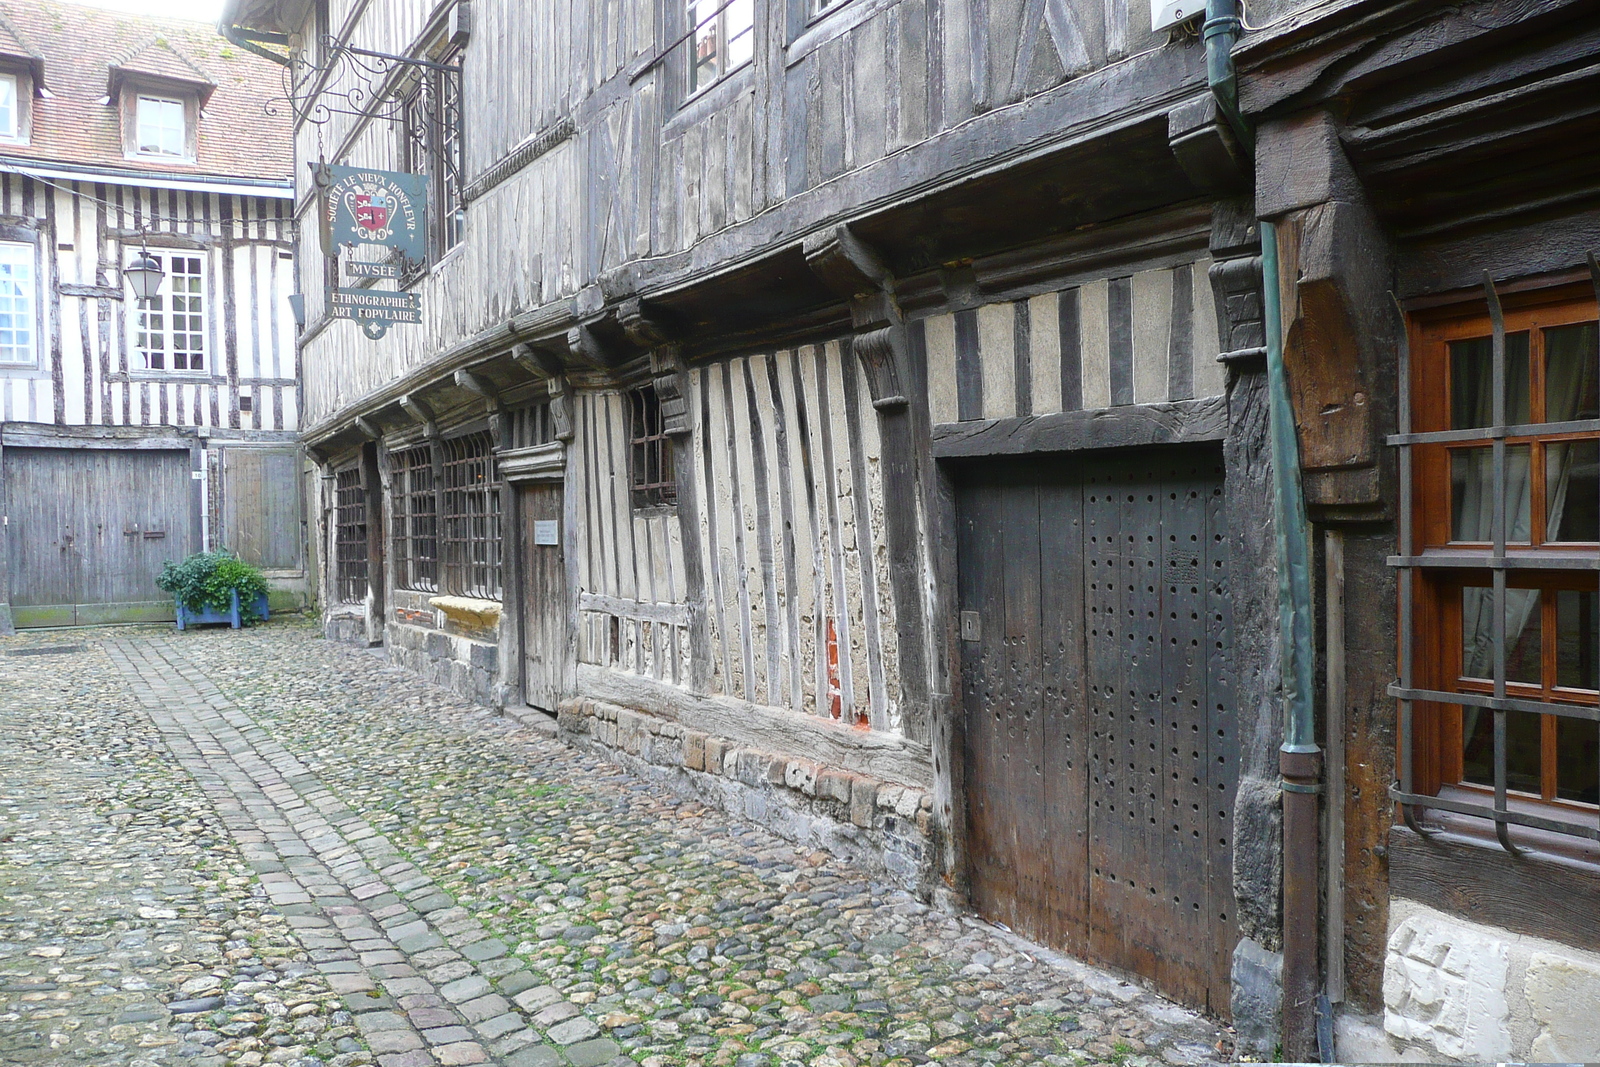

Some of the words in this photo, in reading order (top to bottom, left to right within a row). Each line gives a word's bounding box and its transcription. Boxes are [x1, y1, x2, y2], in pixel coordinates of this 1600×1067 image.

[343, 175, 356, 187] LE
[357, 173, 387, 186] VIEVX
[388, 181, 416, 231] HONFLEVR
[331, 293, 408, 308] ETHNOGRAPHIE
[409, 301, 417, 309] &
[331, 306, 353, 317] ART
